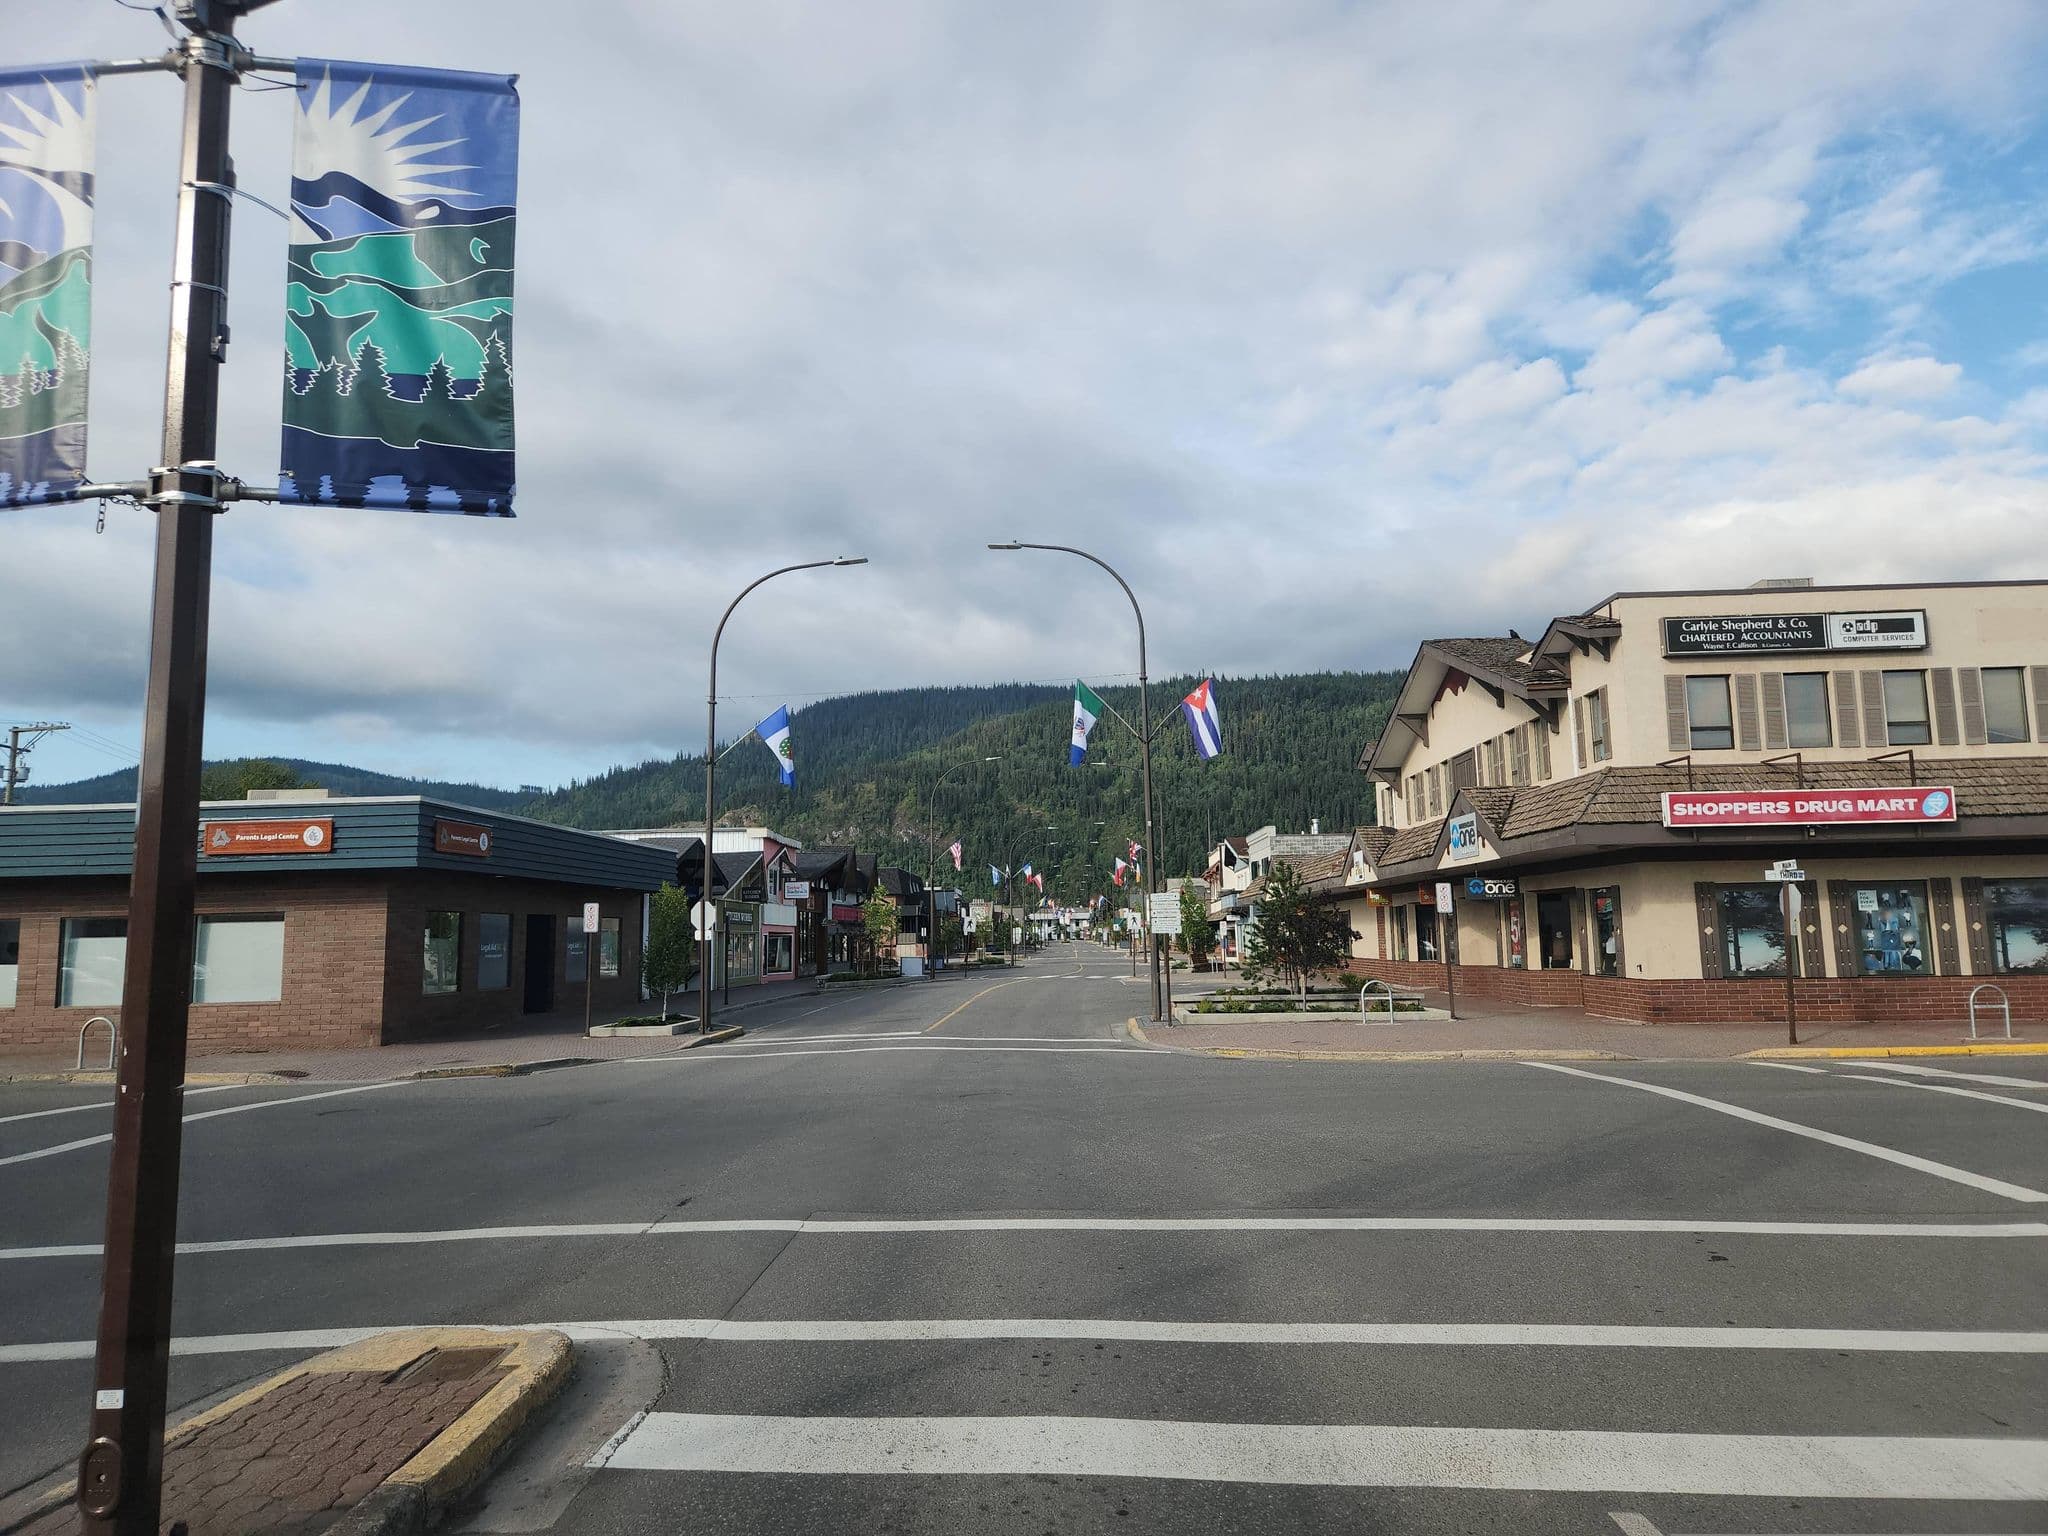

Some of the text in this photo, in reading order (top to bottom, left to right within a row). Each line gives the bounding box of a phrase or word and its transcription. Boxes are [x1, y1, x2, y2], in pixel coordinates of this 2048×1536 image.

[1682, 618, 1808, 633] Carlyle Shepherd & Co.
[1679, 630, 1812, 642] CHARTERED ACCOUNTANTS
[1672, 798, 1917, 816] SHOPPERS DRUG MART
[260, 833, 278, 841] Legal
[1459, 828, 1476, 847] one
[1484, 883, 1516, 894] one
